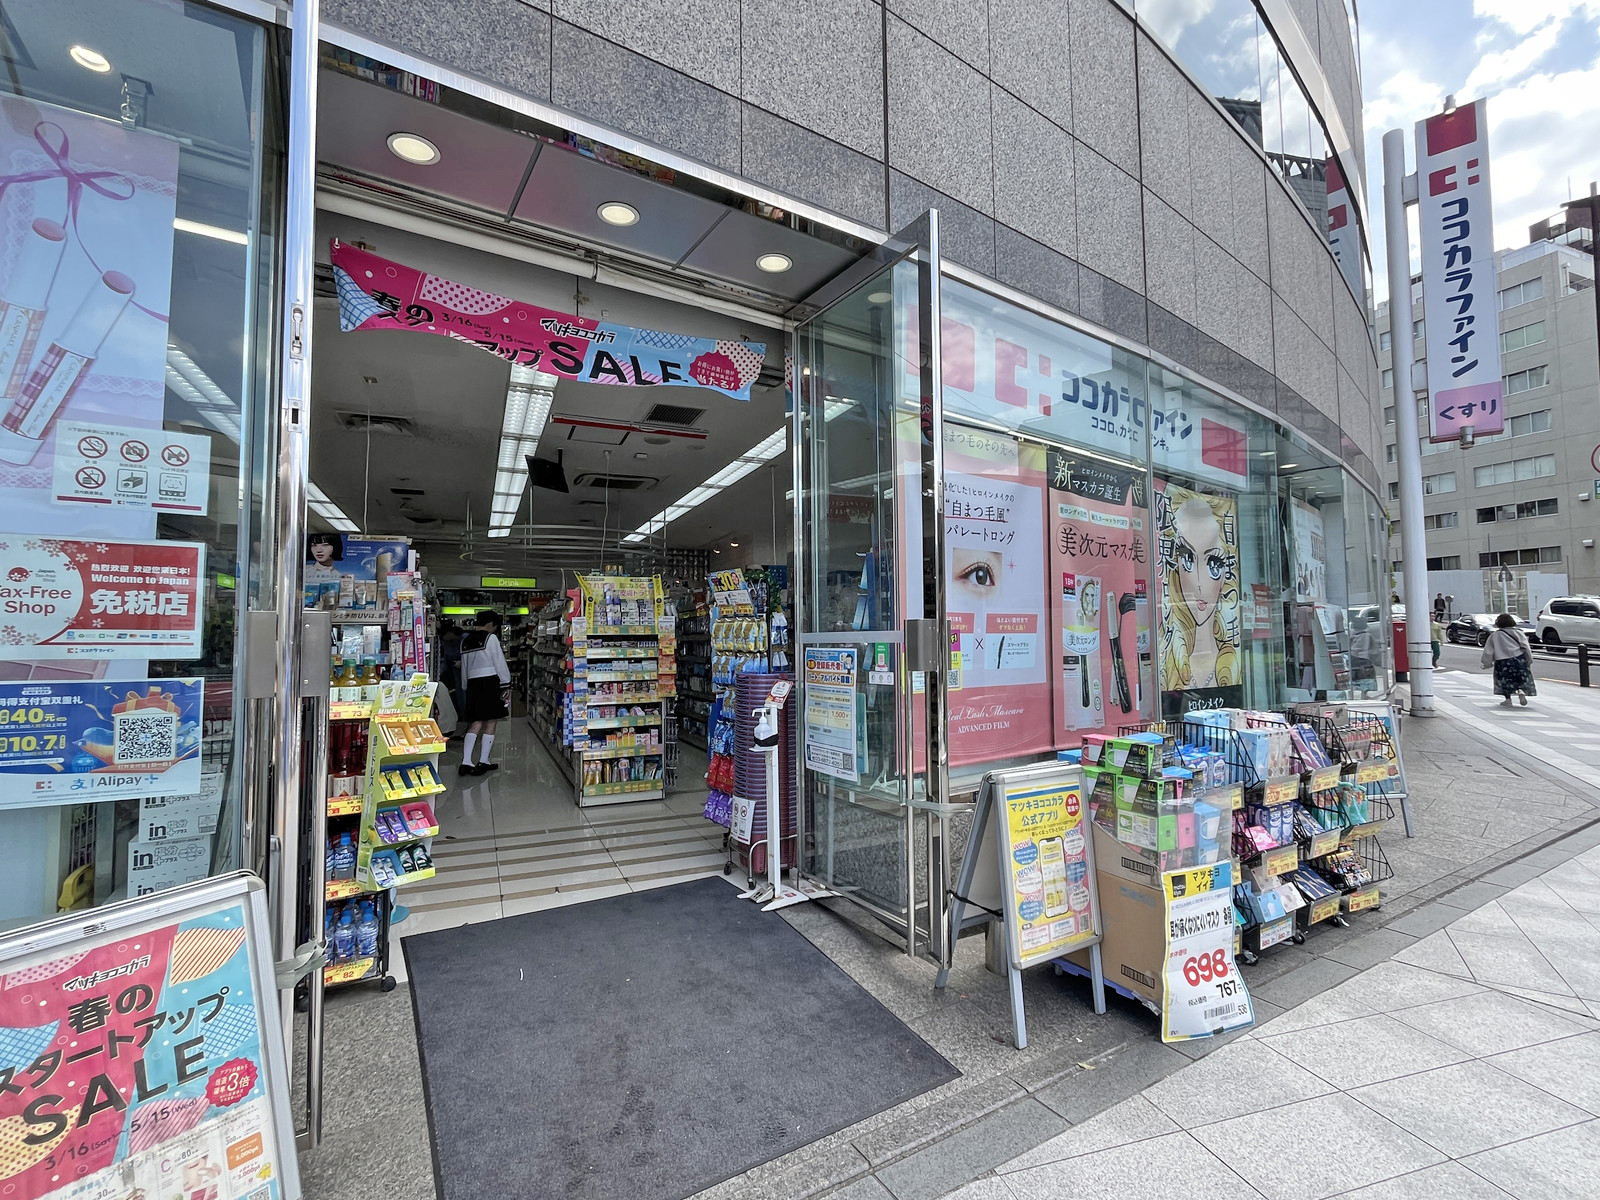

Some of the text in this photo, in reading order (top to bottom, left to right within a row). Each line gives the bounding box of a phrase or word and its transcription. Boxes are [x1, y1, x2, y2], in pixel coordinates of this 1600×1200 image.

[1441, 197, 1479, 378] ココカラファイン
[1439, 398, 1497, 421] くすり
[1053, 455, 1076, 490] 新
[1072, 480, 1121, 501] マスカラ誕生
[91, 574, 190, 586] Welcome to Japan
[498, 578, 519, 587] Drink
[0, 585, 72, 600] ax-Free
[4, 600, 56, 617] Shop
[90, 589, 189, 616] 免税店
[1188, 697, 1224, 711] ヒロインメイク
[957, 721, 1010, 734] ADVANCED FILM
[97, 776, 142, 787] Alipay
[1010, 795, 1064, 812] マツキヨココカラ
[1022, 810, 1058, 827] 公式アプリ
[149, 822, 166, 838] in
[133, 850, 153, 867] in
[1192, 867, 1220, 881] マツキヨ
[1196, 879, 1215, 891] イイヨ
[1183, 948, 1229, 987] 698
[1215, 979, 1238, 999] 767
[68, 984, 154, 1036] 春の
[0, 986, 229, 1096] スタートアップ
[22, 1035, 209, 1146] SALE
[227, 1072, 251, 1092] 3倍
